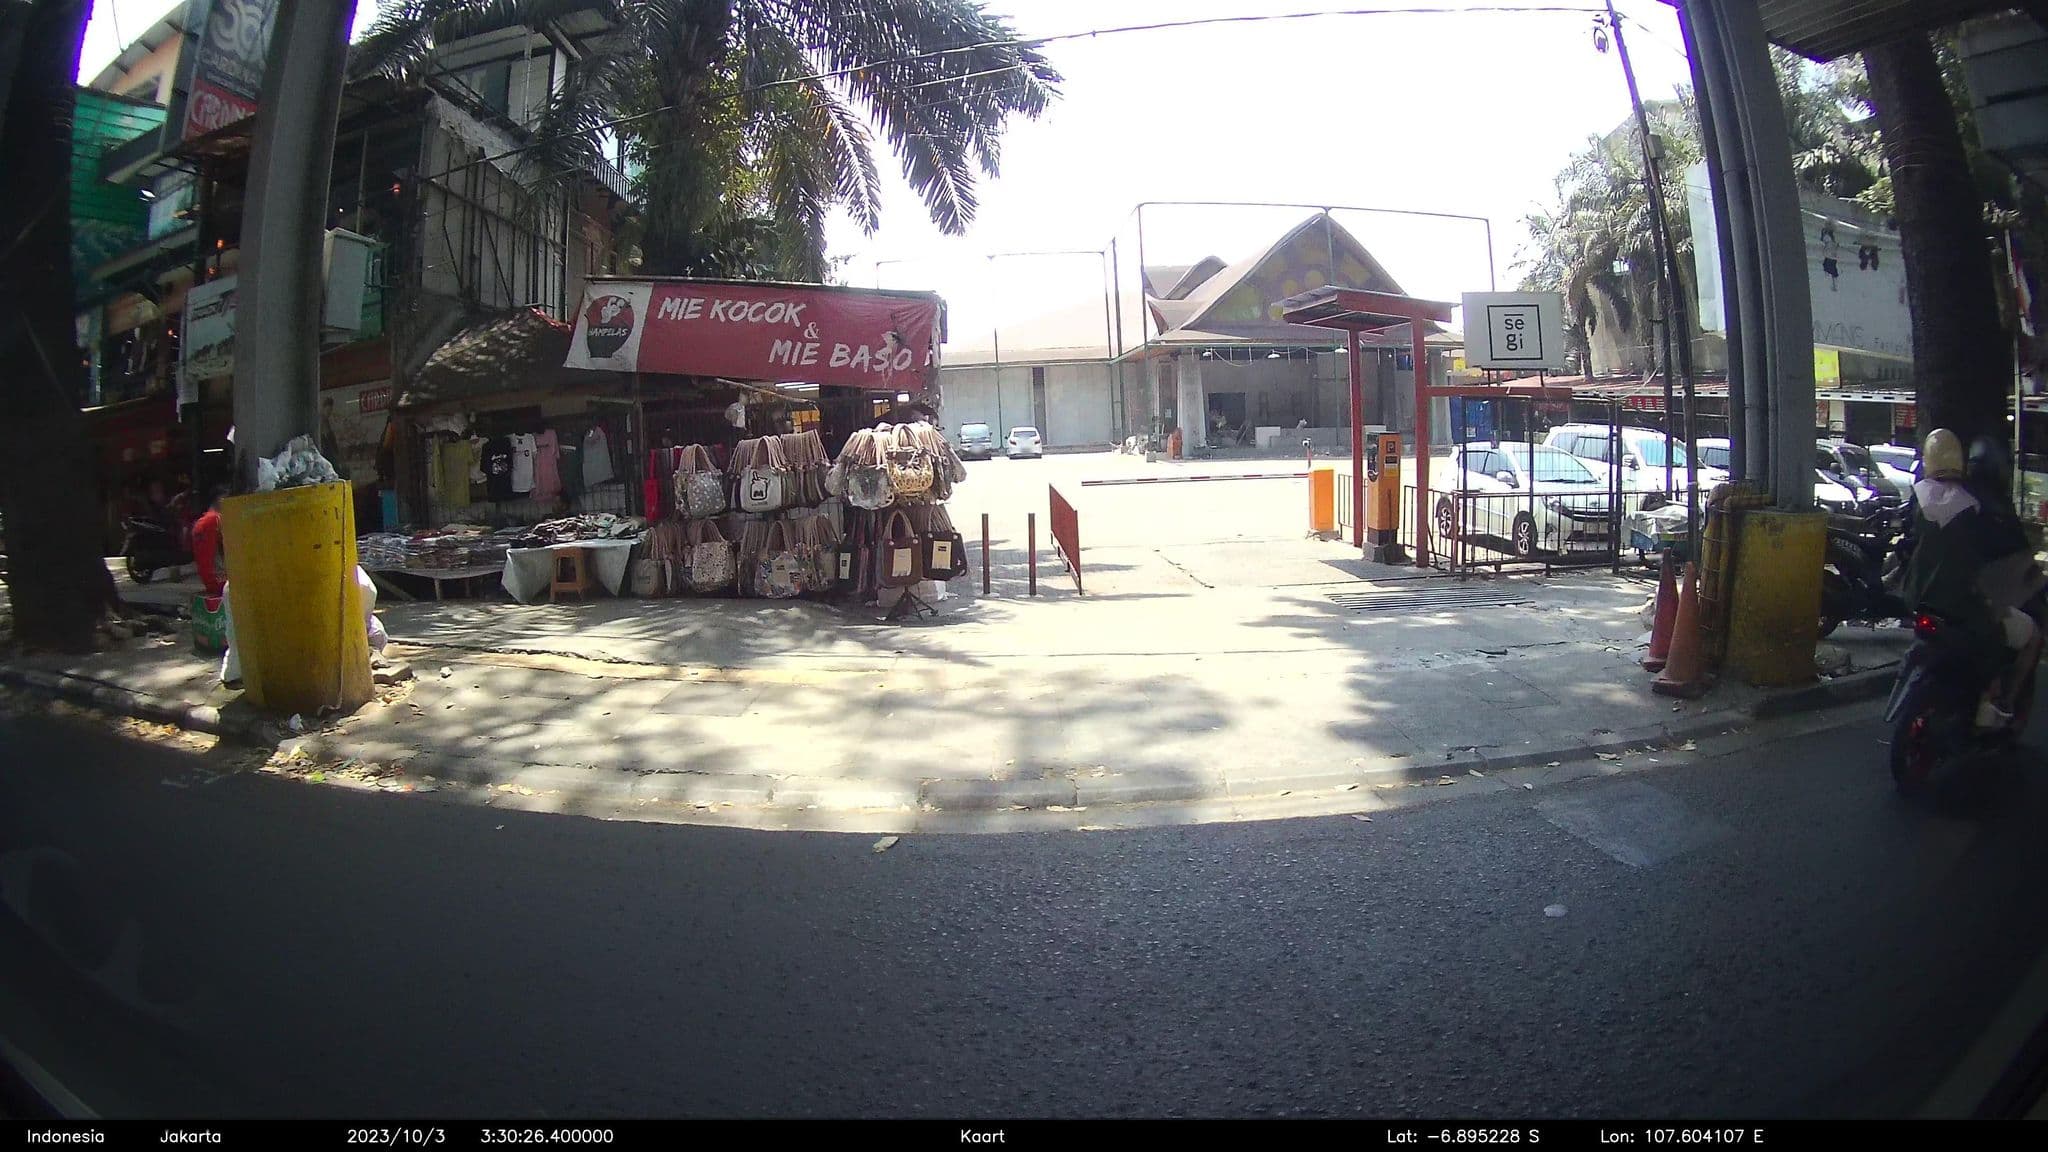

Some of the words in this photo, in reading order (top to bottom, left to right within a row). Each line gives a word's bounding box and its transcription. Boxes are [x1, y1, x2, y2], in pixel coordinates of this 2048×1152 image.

[657, 297, 705, 320] MIE
[709, 299, 806, 327] KOCOK
[803, 321, 820, 339] &
[1506, 333, 1523, 351] gi
[768, 339, 821, 366] MIE
[829, 342, 913, 373] BASO
